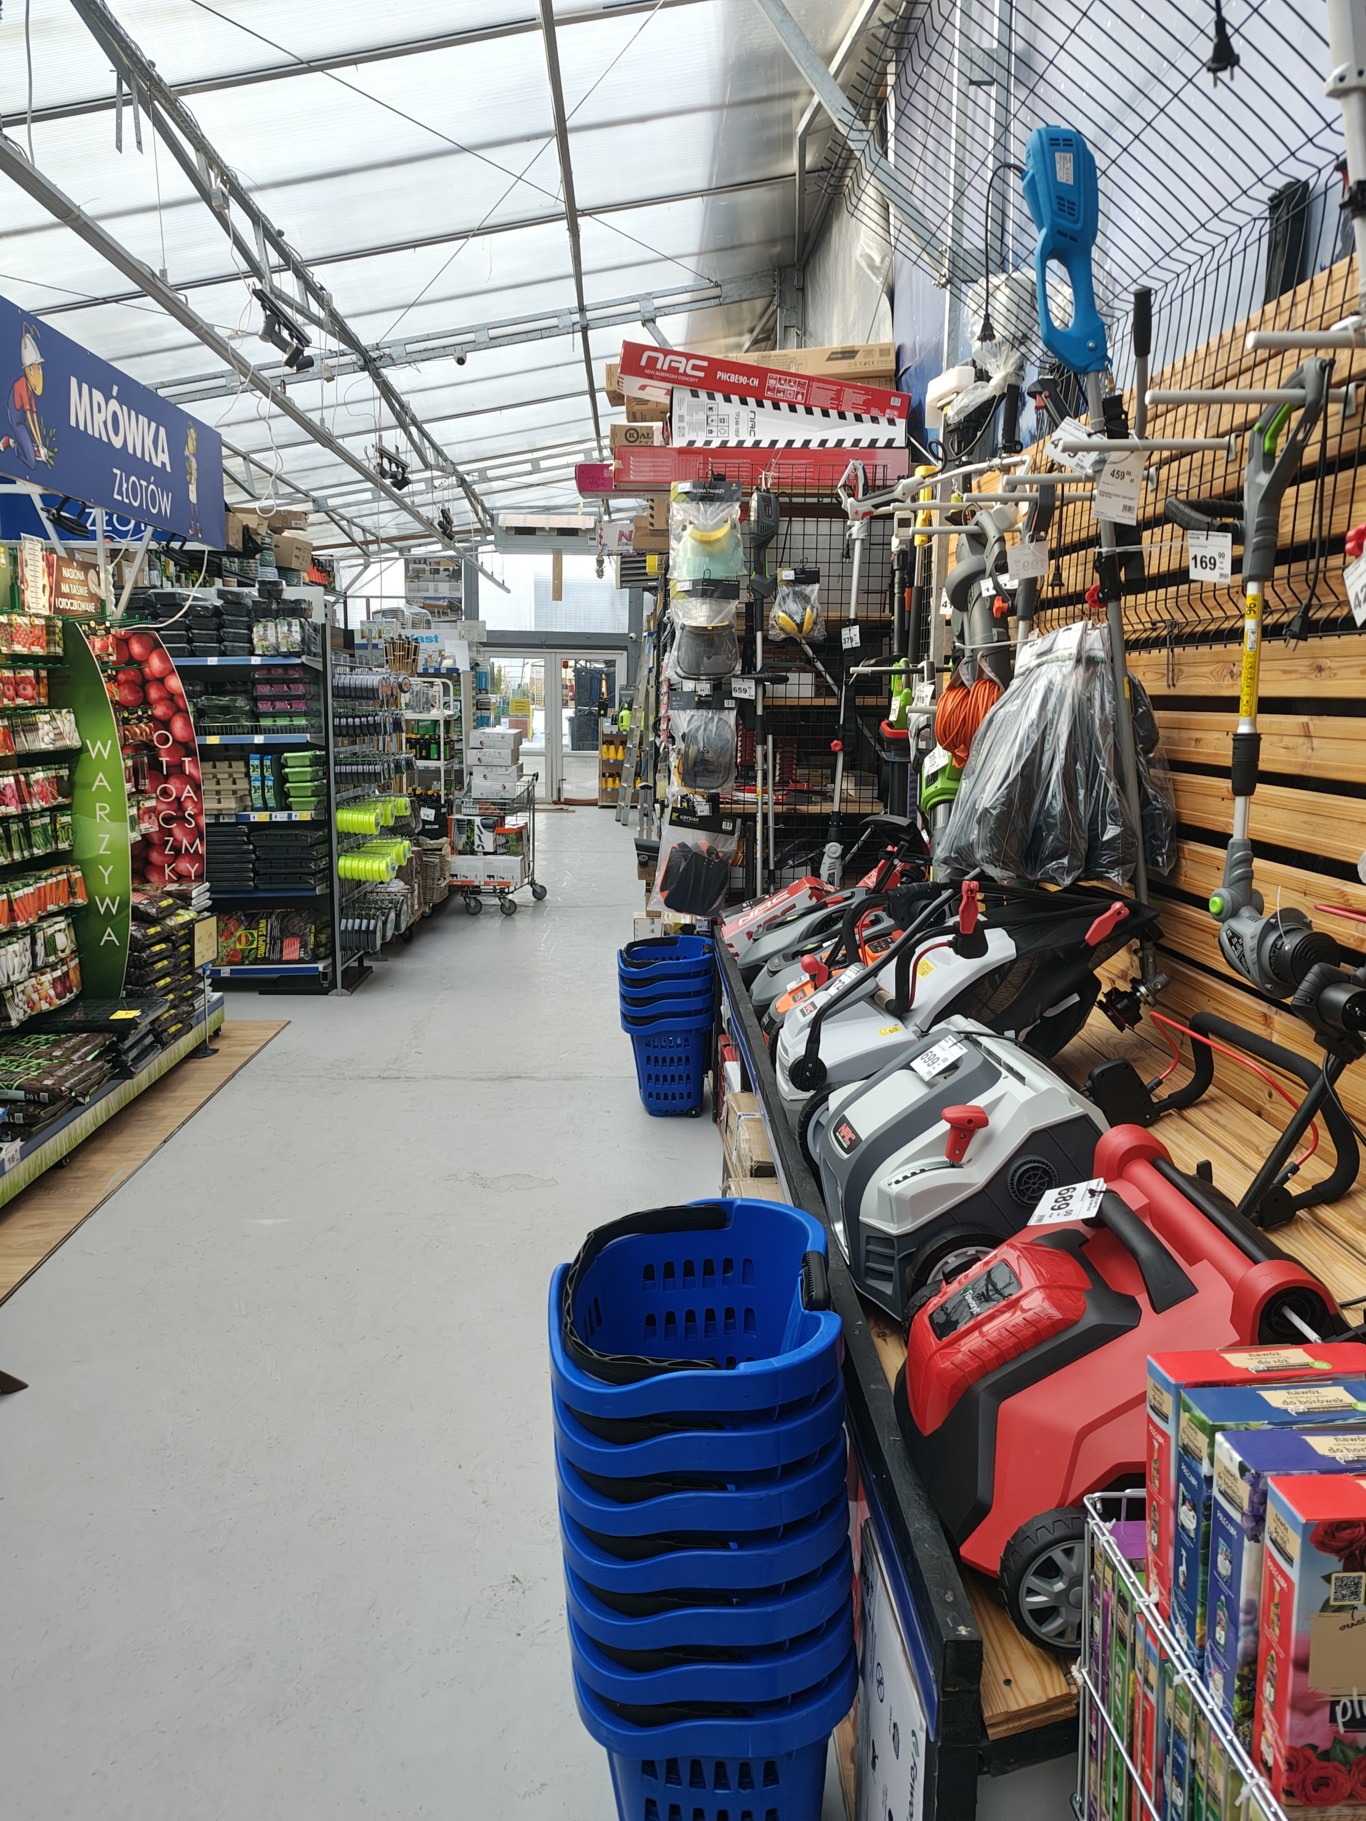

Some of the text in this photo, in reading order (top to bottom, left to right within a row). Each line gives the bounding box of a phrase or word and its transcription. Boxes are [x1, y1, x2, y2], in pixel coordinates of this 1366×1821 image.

[640, 350, 708, 377] NAC
[655, 370, 678, 381] AMERICAN
[677, 373, 699, 384] CONCEPT
[716, 371, 760, 387] PHCBE90-CH
[70, 376, 171, 473] MRÓWKA
[1110, 469, 1126, 481] 459
[113, 467, 172, 520] ZŁOTÓW
[1191, 551, 1226, 571] 169 00
[62, 566, 86, 582] NASIONA
[60, 582, 89, 597] NA TAŚMIE
[732, 686, 748, 695] 659
[181, 757, 202, 881] TAŚMY
[86, 739, 120, 947] WARZYWA
[738, 889, 791, 927] NAC
[920, 1050, 941, 1068] 699
[1050, 1186, 1077, 1211] 689
[1298, 1397, 1345, 1405] borówek
